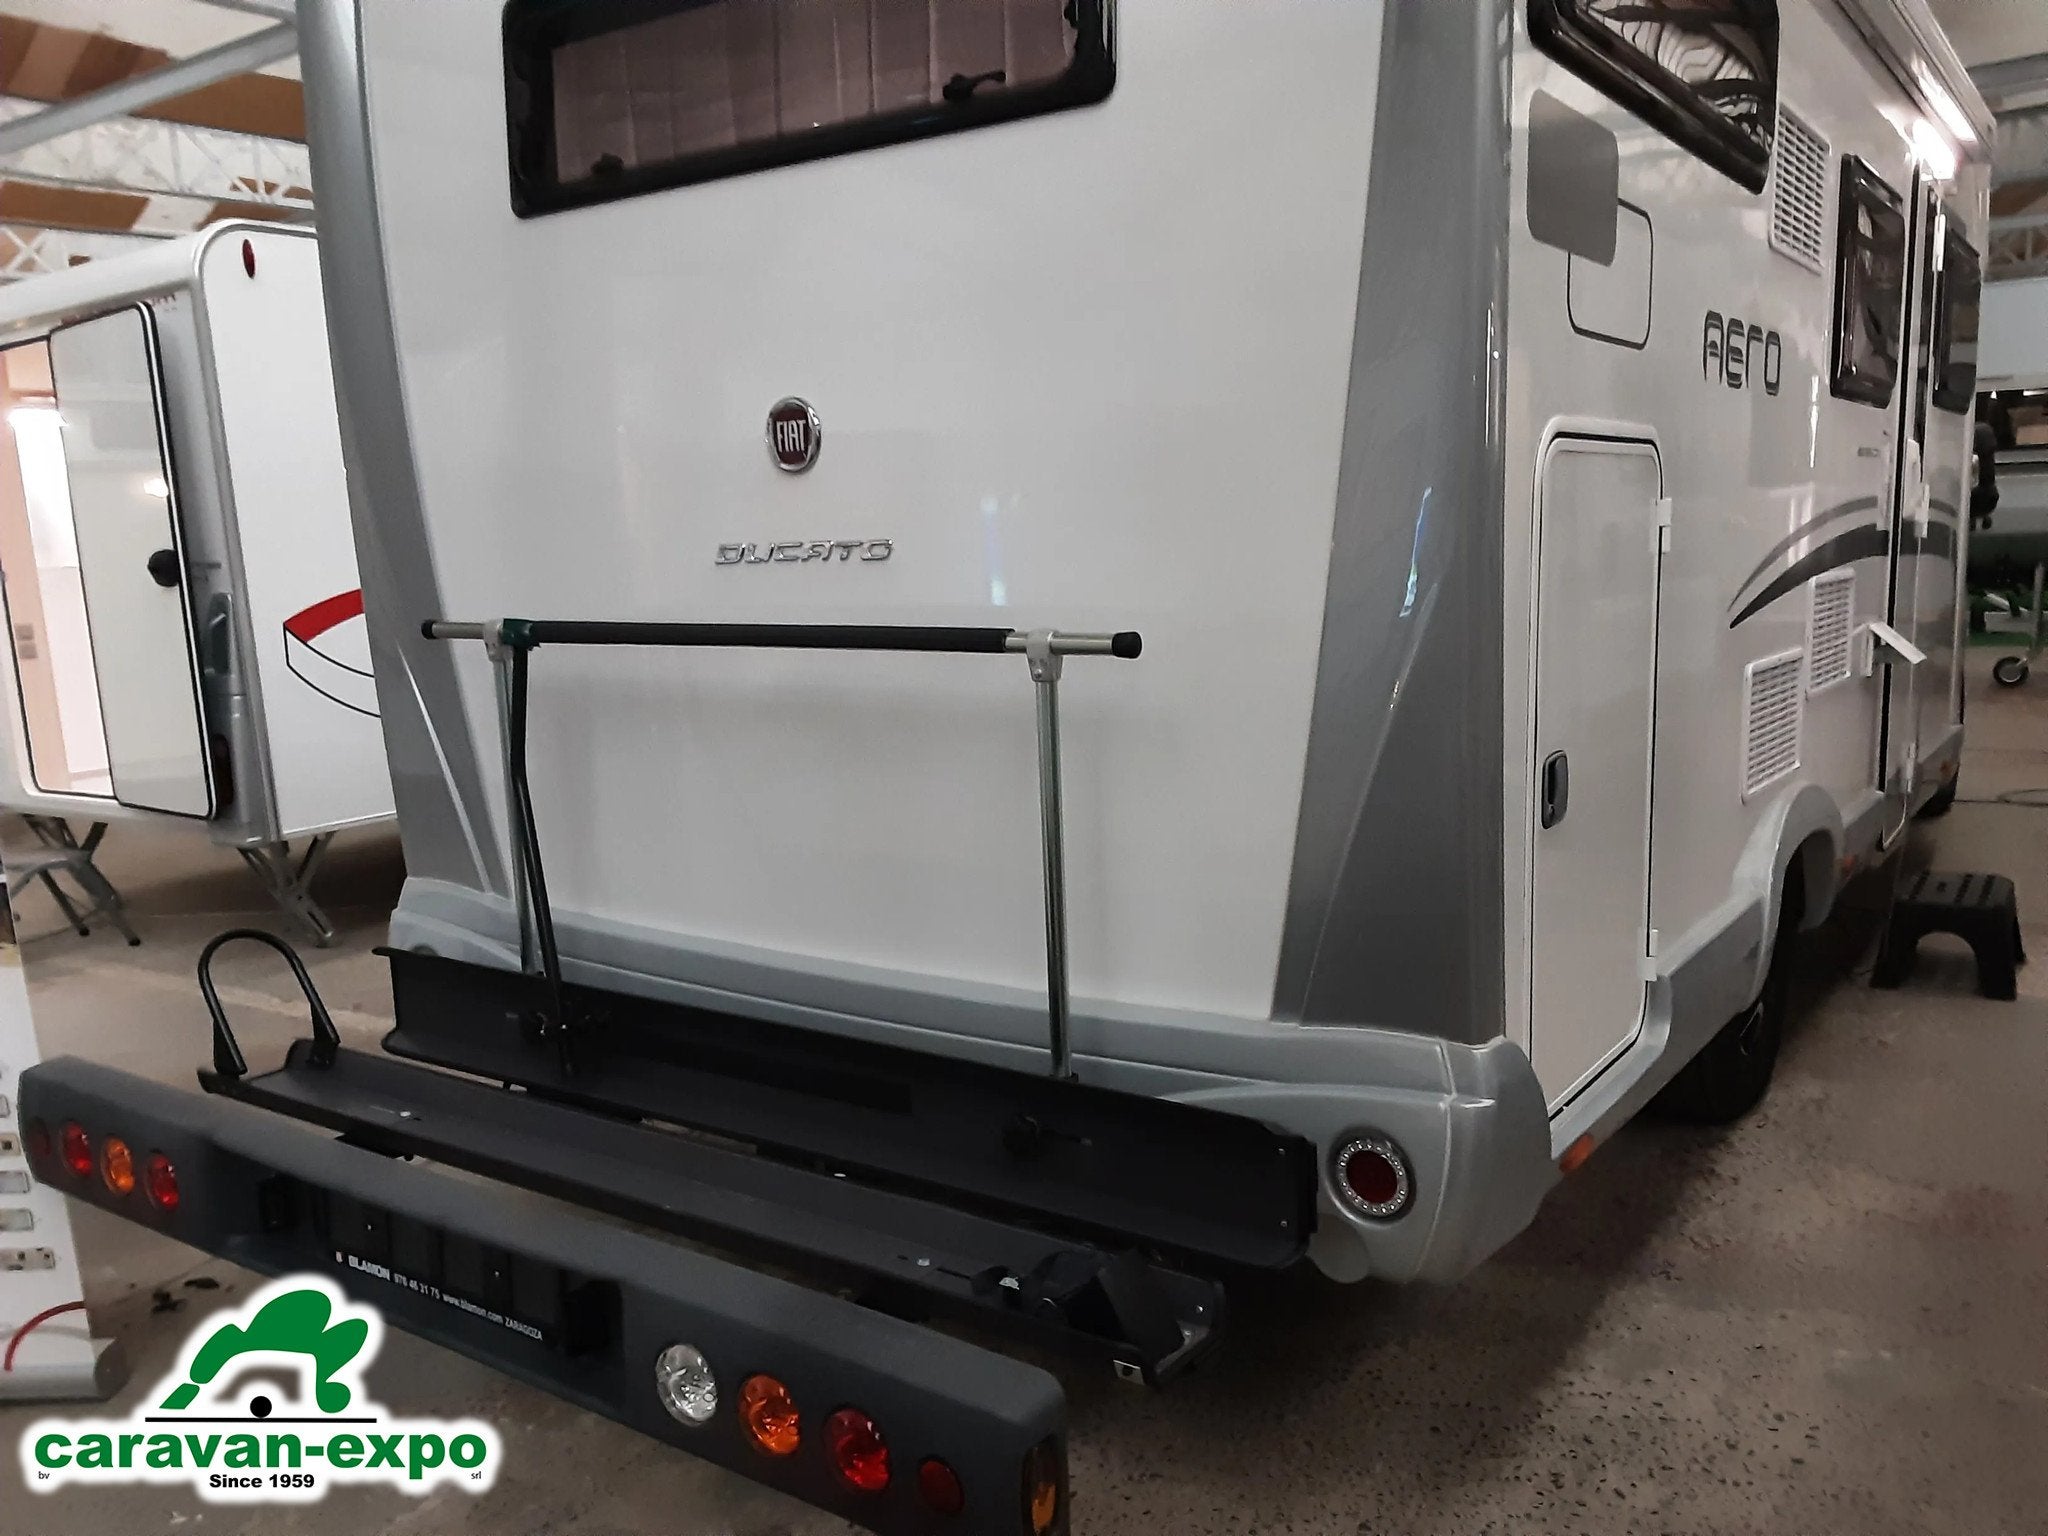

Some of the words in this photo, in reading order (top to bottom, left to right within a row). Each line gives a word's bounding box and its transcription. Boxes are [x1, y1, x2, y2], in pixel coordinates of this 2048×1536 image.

[1703, 310, 1781, 396] AERO
[776, 419, 807, 453] FIAT
[715, 539, 895, 565] DUCATO
